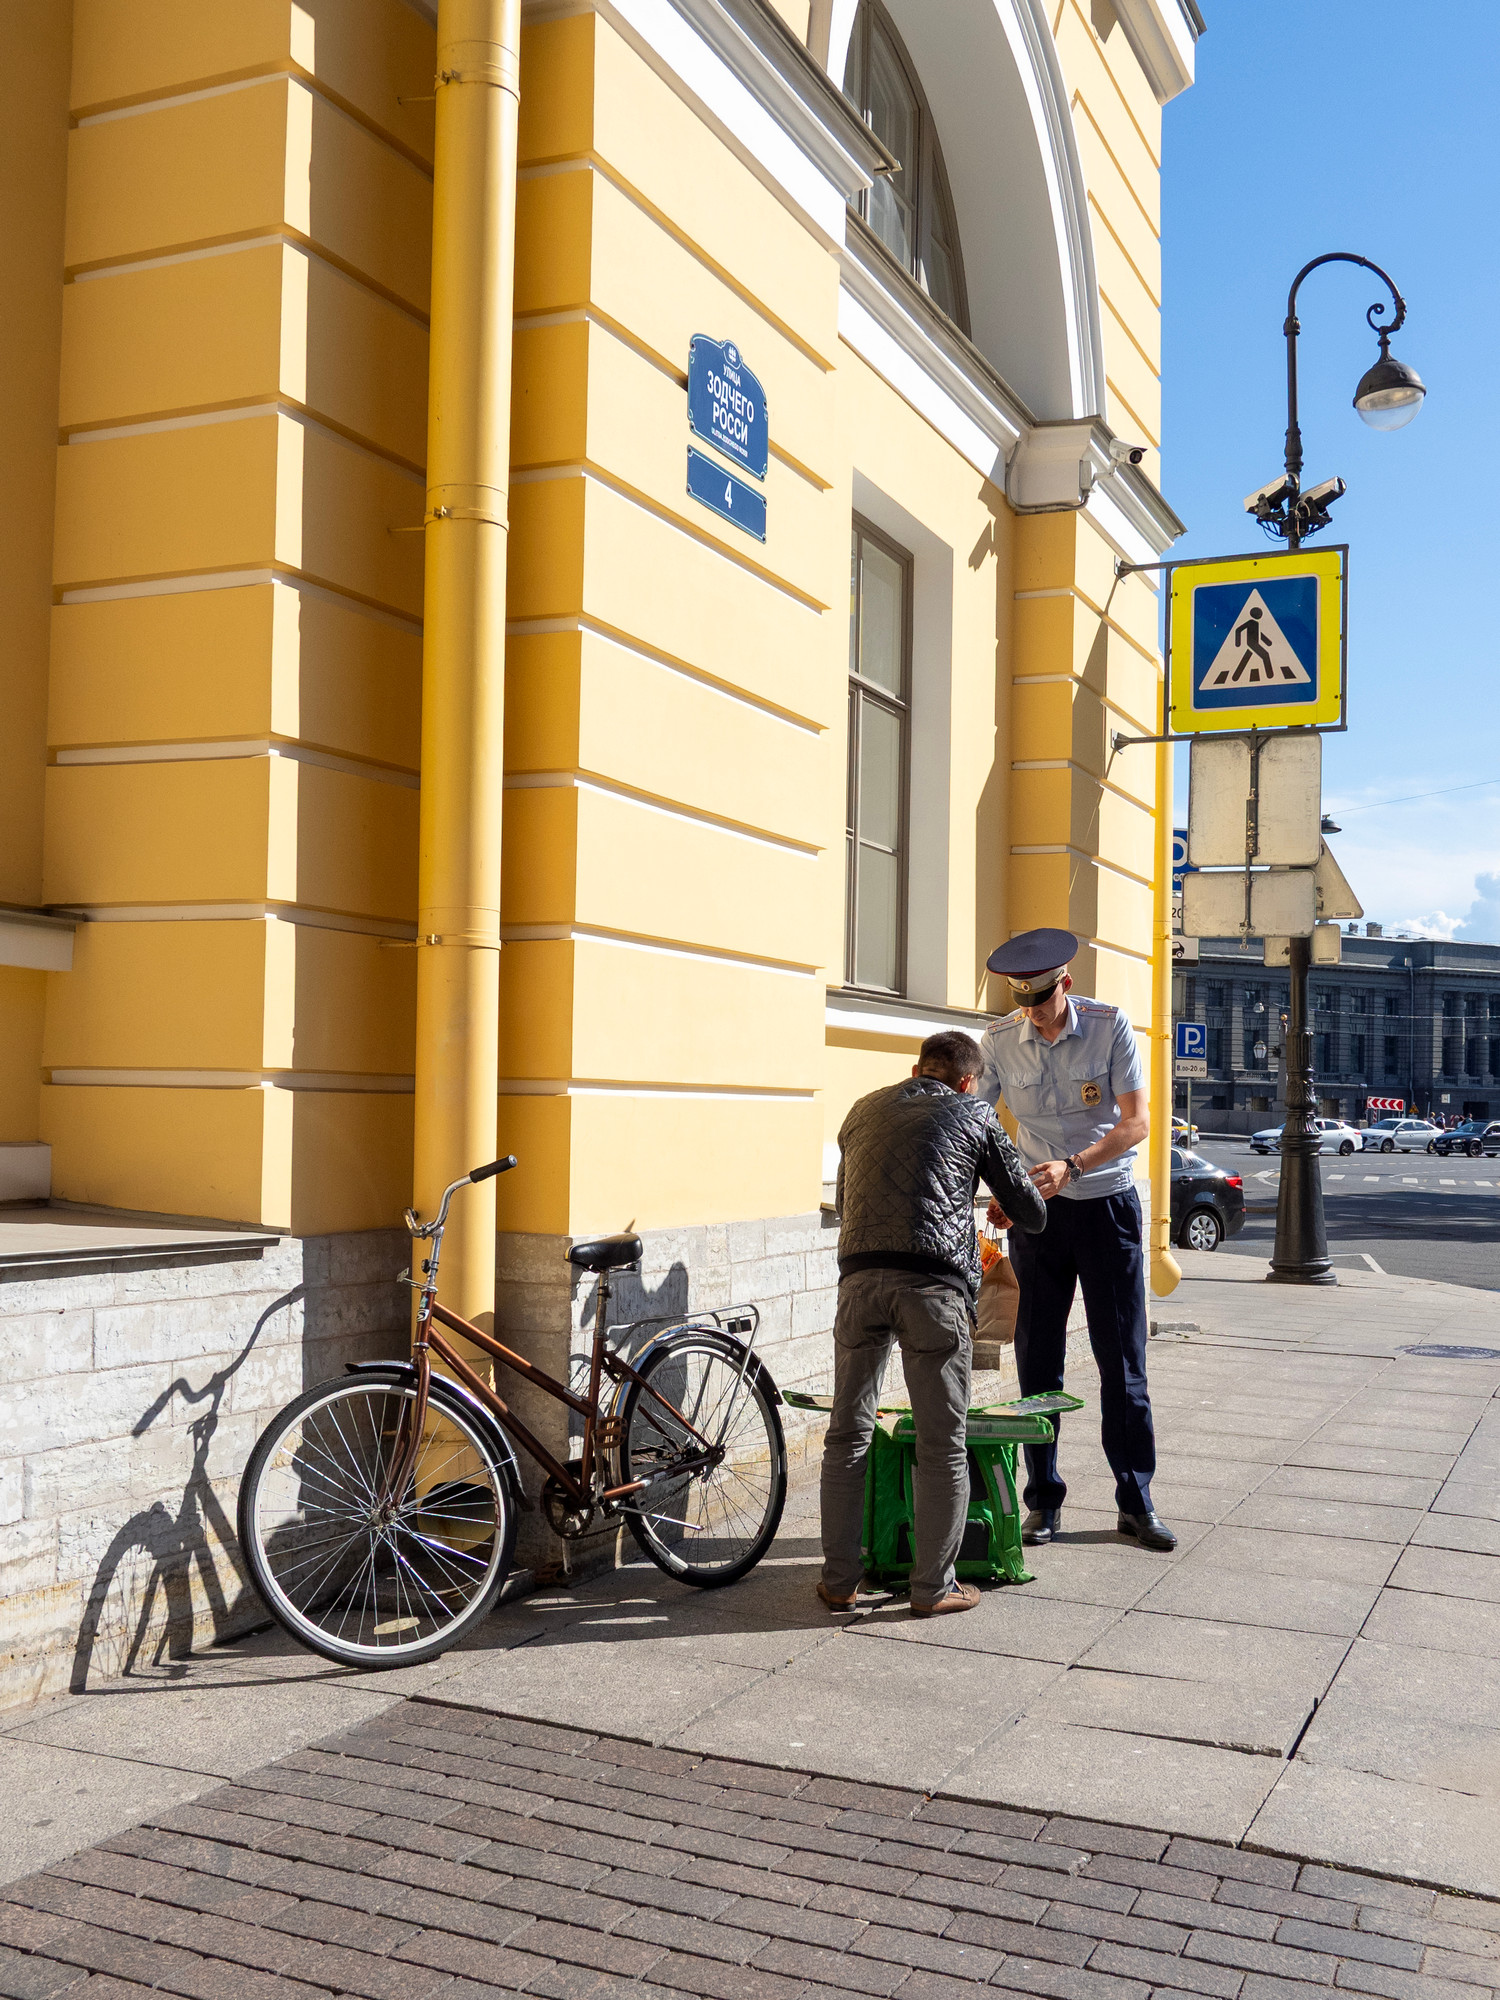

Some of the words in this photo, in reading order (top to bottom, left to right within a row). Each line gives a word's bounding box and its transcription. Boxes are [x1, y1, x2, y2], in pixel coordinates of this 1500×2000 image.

[723, 364, 741, 387] УЛИЦА
[707, 370, 754, 423] ЗОДЧЕГО
[713, 401, 748, 446] РОССИ
[724, 480, 733, 509] 4
[1184, 1027, 1201, 1054] P
